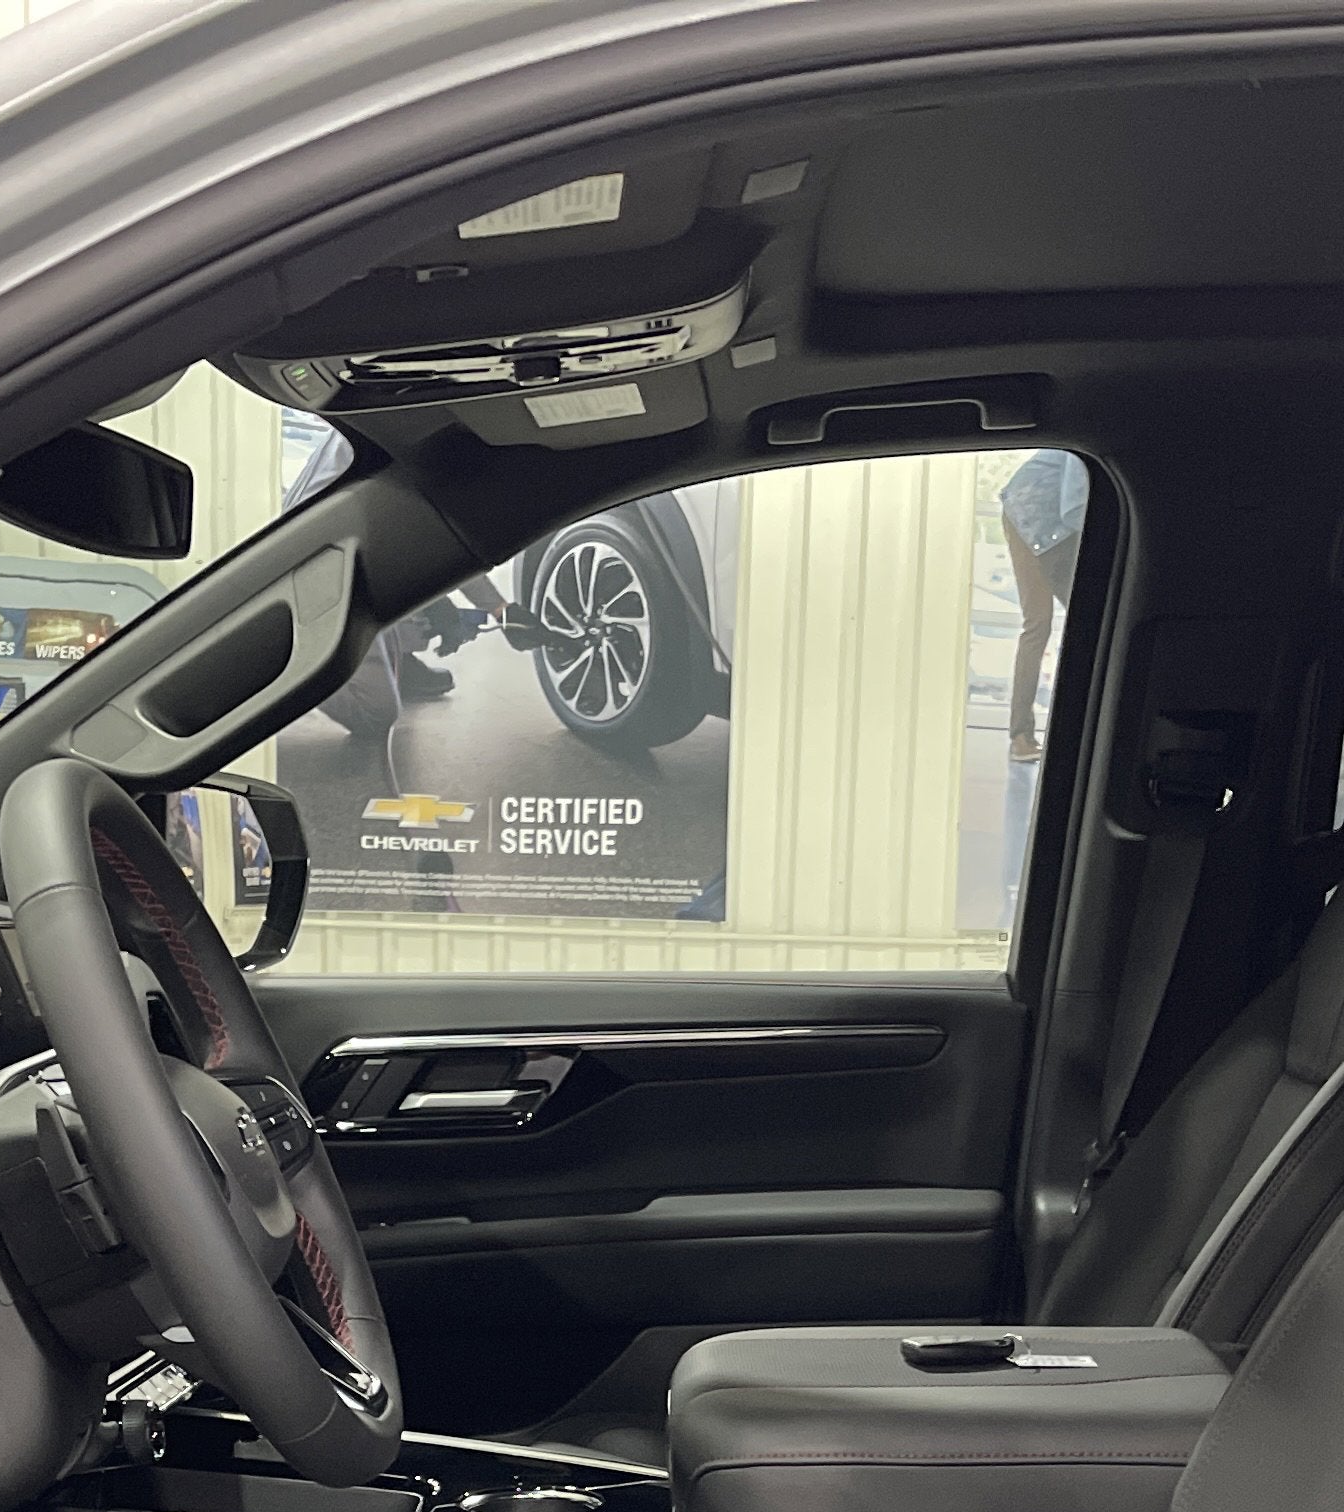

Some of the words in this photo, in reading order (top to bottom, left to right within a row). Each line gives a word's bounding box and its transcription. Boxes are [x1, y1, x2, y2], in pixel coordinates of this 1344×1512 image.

[35, 645, 85, 660] WIPERS
[500, 797, 643, 825] CERTIFIED
[360, 835, 480, 853] CHEVROLET
[500, 828, 617, 856] SERVICE
